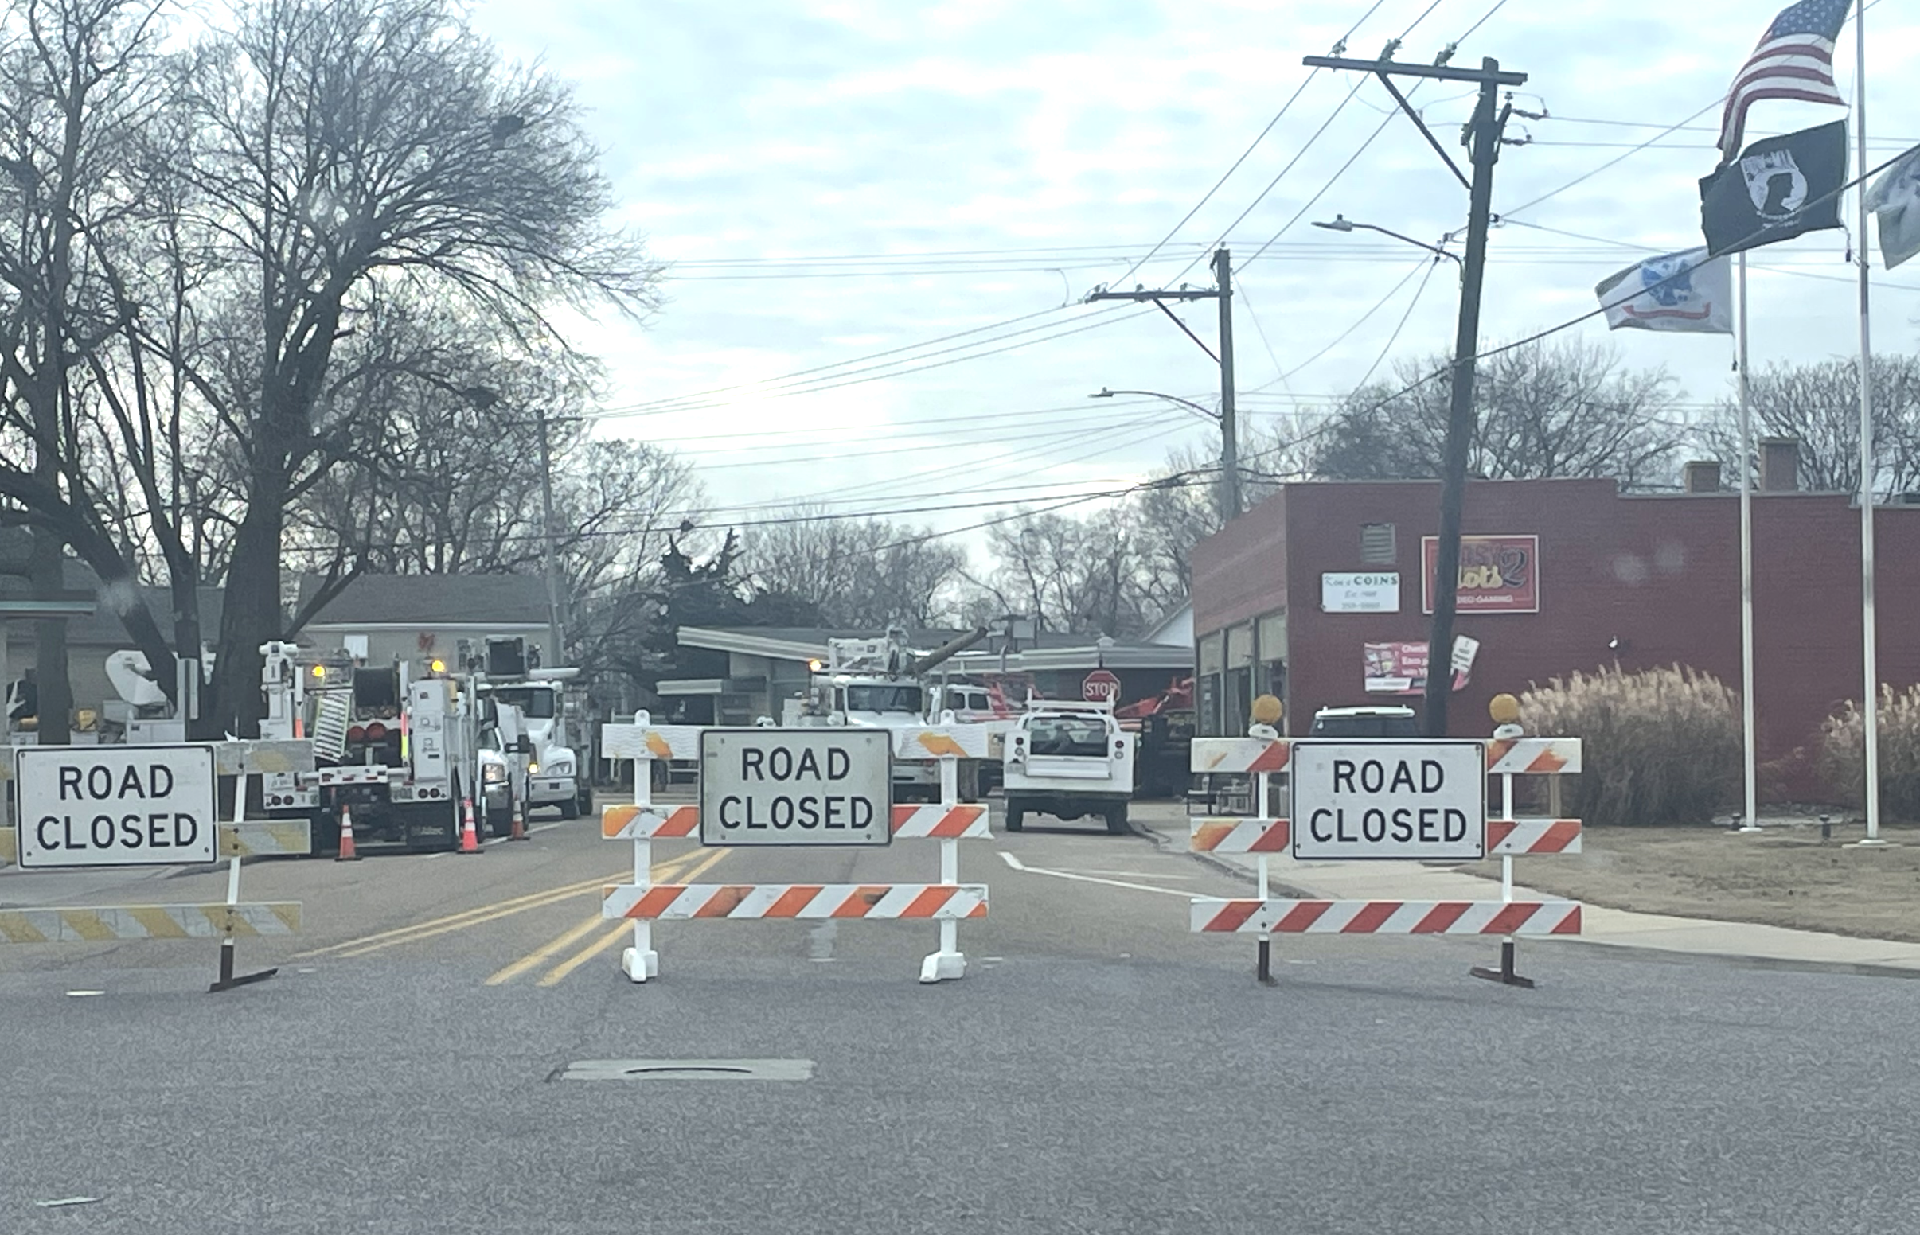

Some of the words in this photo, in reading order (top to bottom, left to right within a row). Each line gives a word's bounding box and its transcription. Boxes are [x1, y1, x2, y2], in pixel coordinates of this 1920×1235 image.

[1354, 575, 1398, 586] COINS
[1499, 548, 1527, 588] 2
[1086, 682, 1118, 696] STOP
[743, 747, 849, 781] ROAD
[1334, 760, 1443, 793] ROAD
[60, 765, 173, 800] ROAD
[720, 796, 872, 829] CLOSED
[1311, 809, 1466, 842] CLOSED
[37, 813, 197, 850] CLOSED
